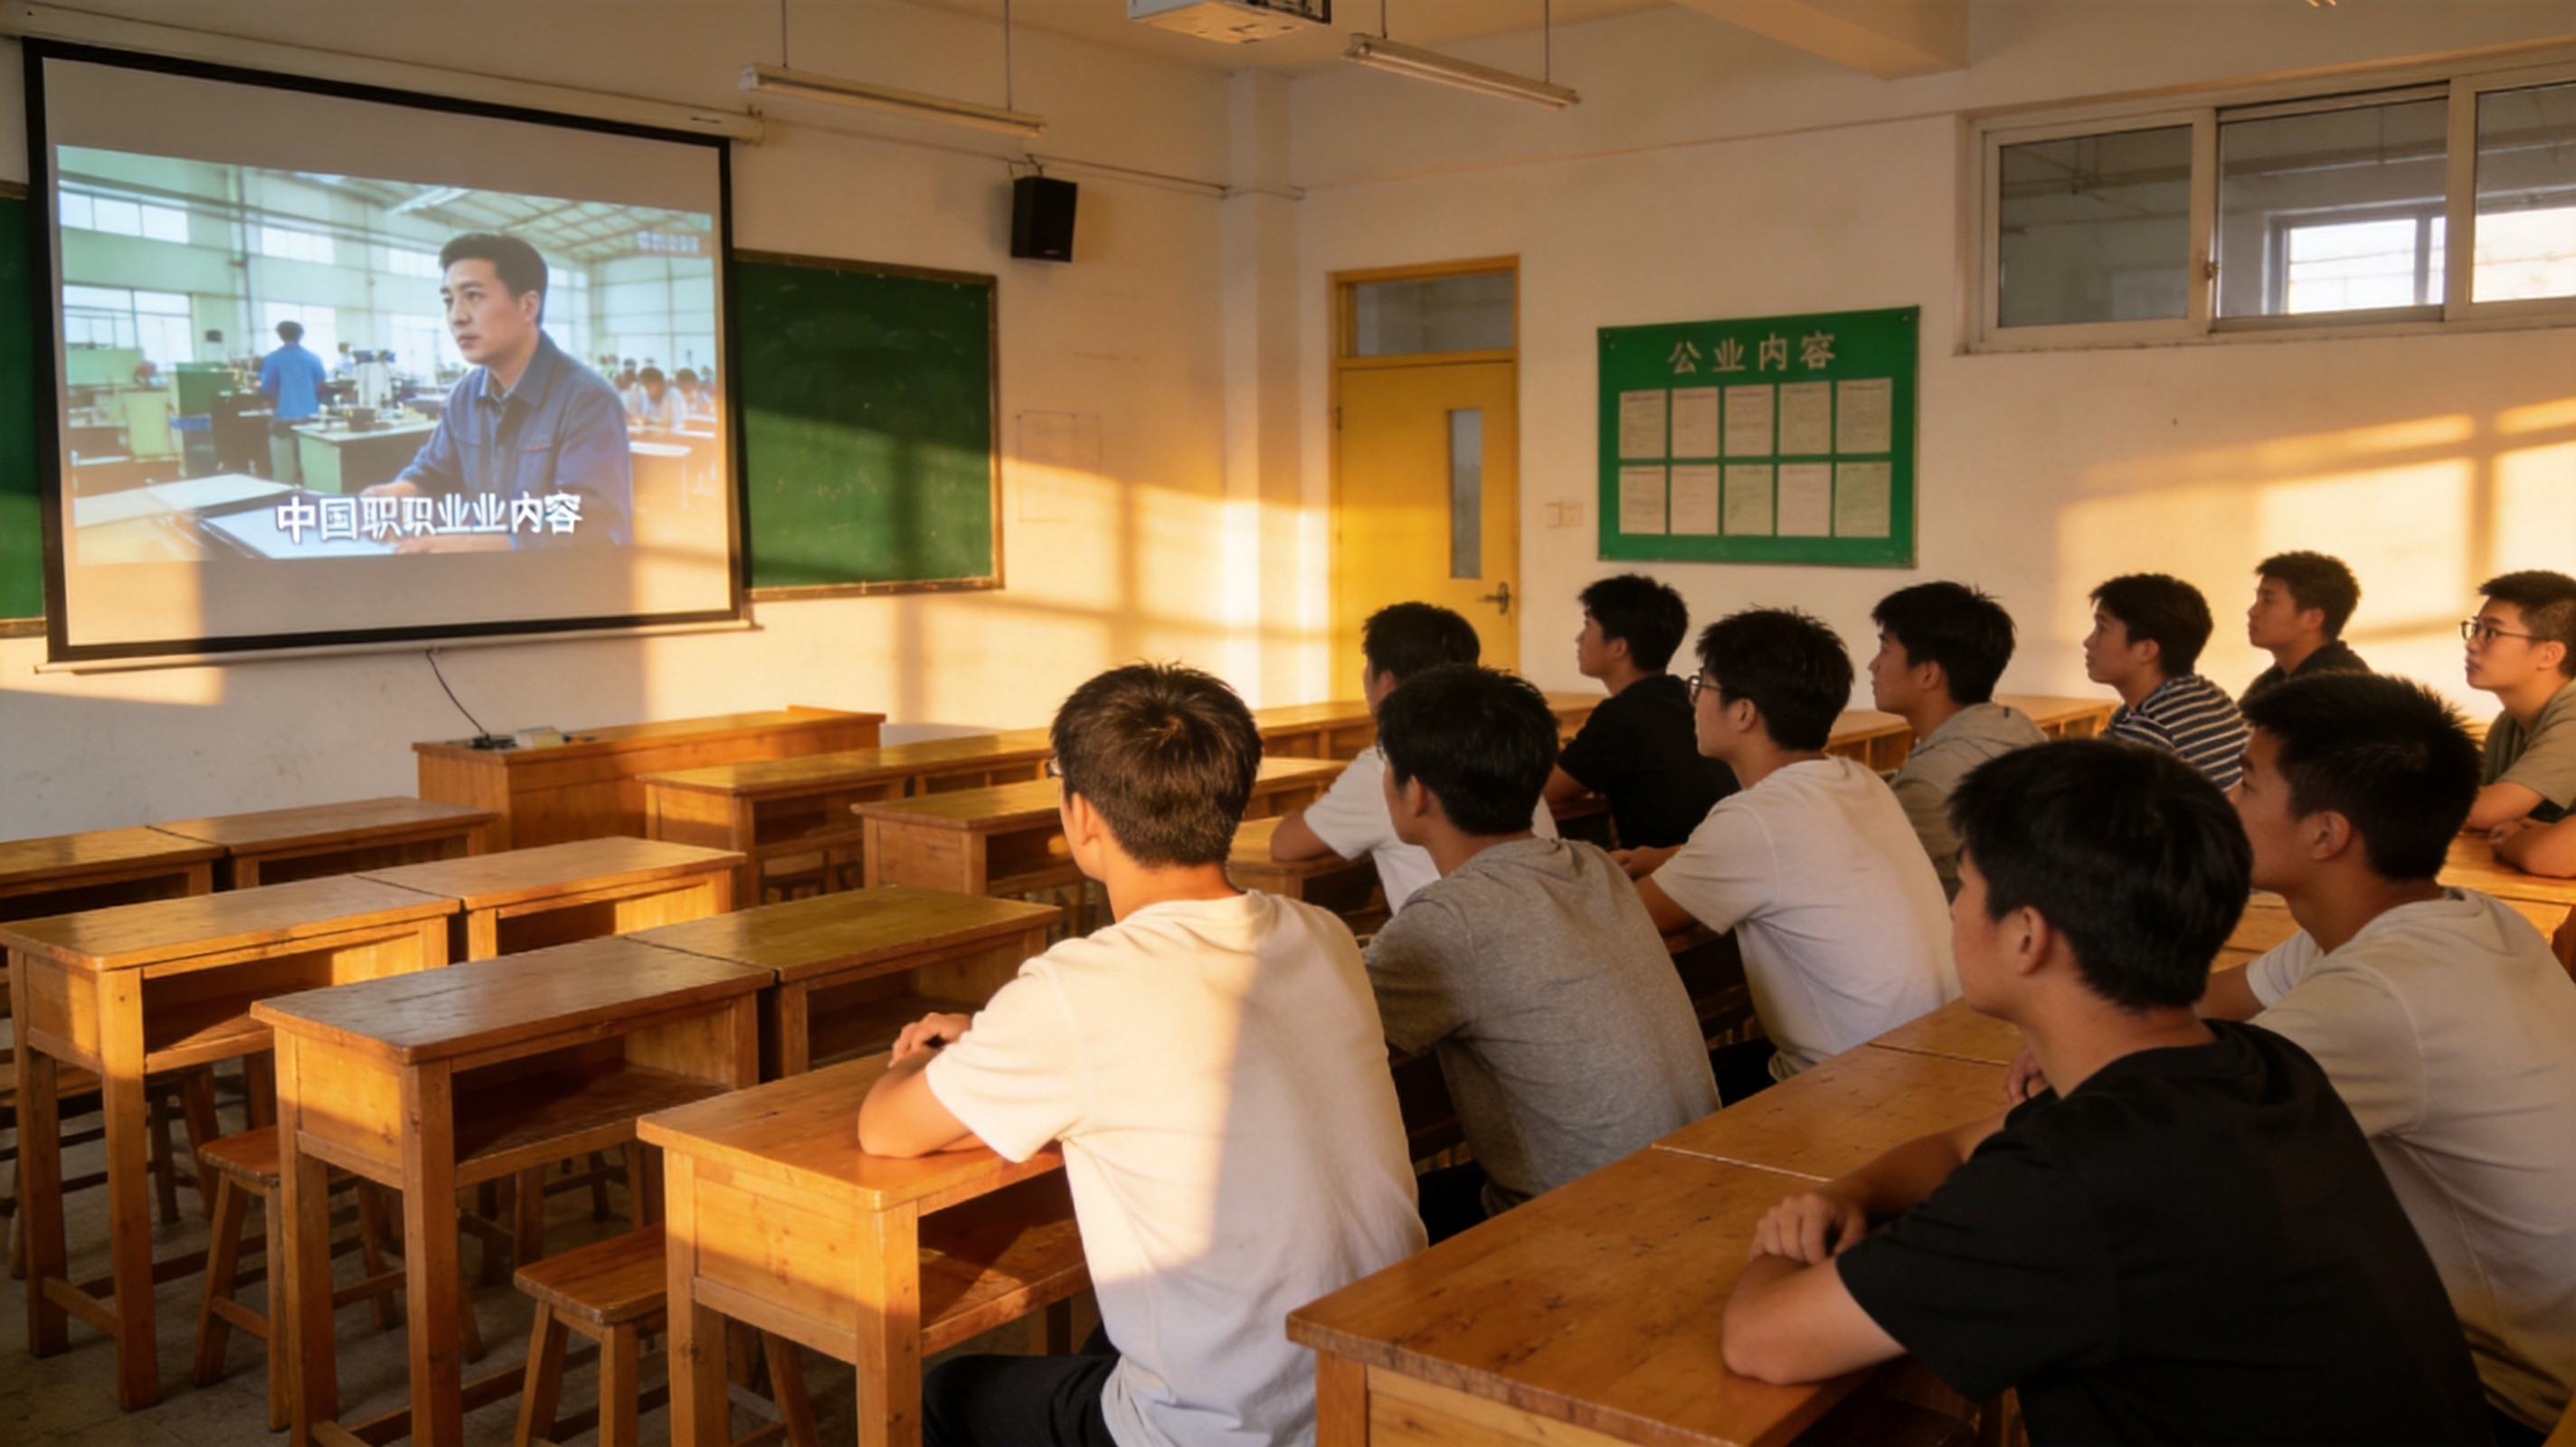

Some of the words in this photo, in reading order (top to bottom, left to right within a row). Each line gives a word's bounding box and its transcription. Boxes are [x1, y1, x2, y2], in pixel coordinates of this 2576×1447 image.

[1668, 330, 1835, 374] 公业内容
[277, 489, 582, 544] 中国职职业业内容
